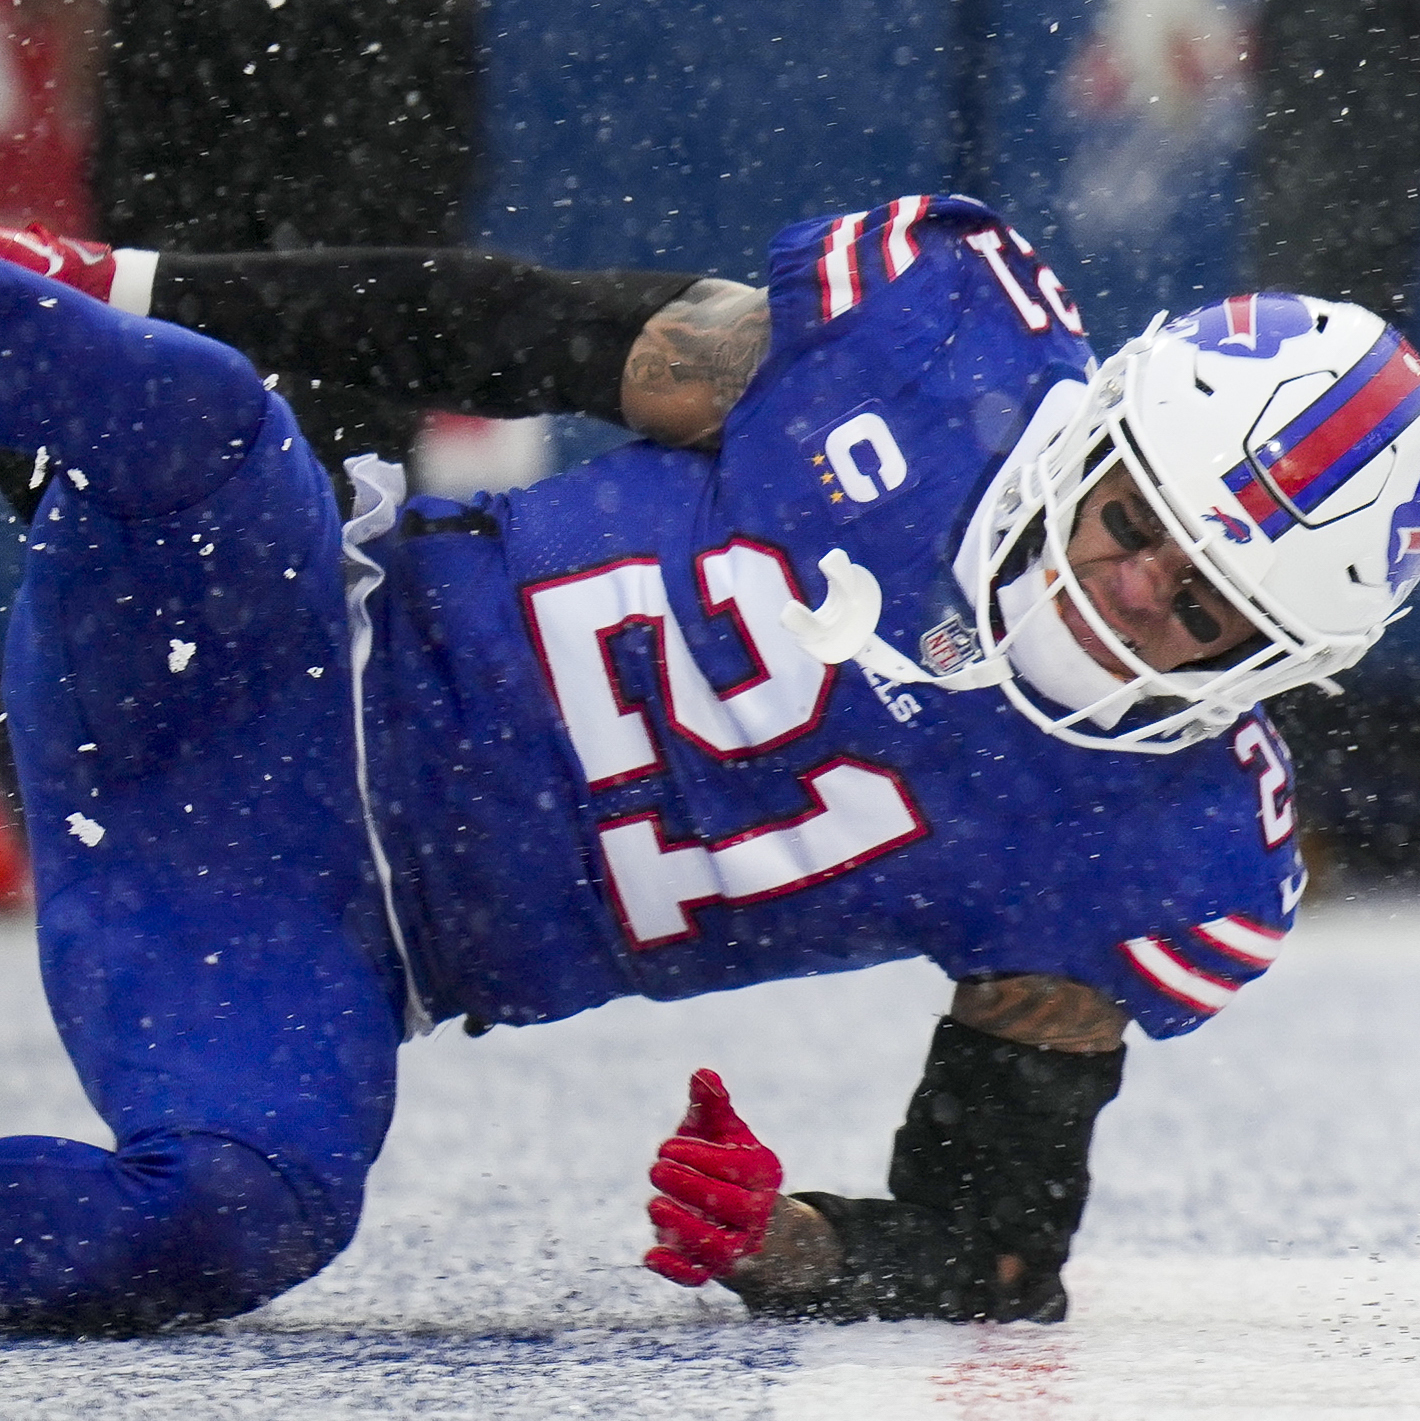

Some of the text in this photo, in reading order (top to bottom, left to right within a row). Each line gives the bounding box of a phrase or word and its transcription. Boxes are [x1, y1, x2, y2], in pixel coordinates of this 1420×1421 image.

[825, 412, 908, 503] C
[927, 631, 958, 670] NFL
[520, 536, 930, 952] 21
